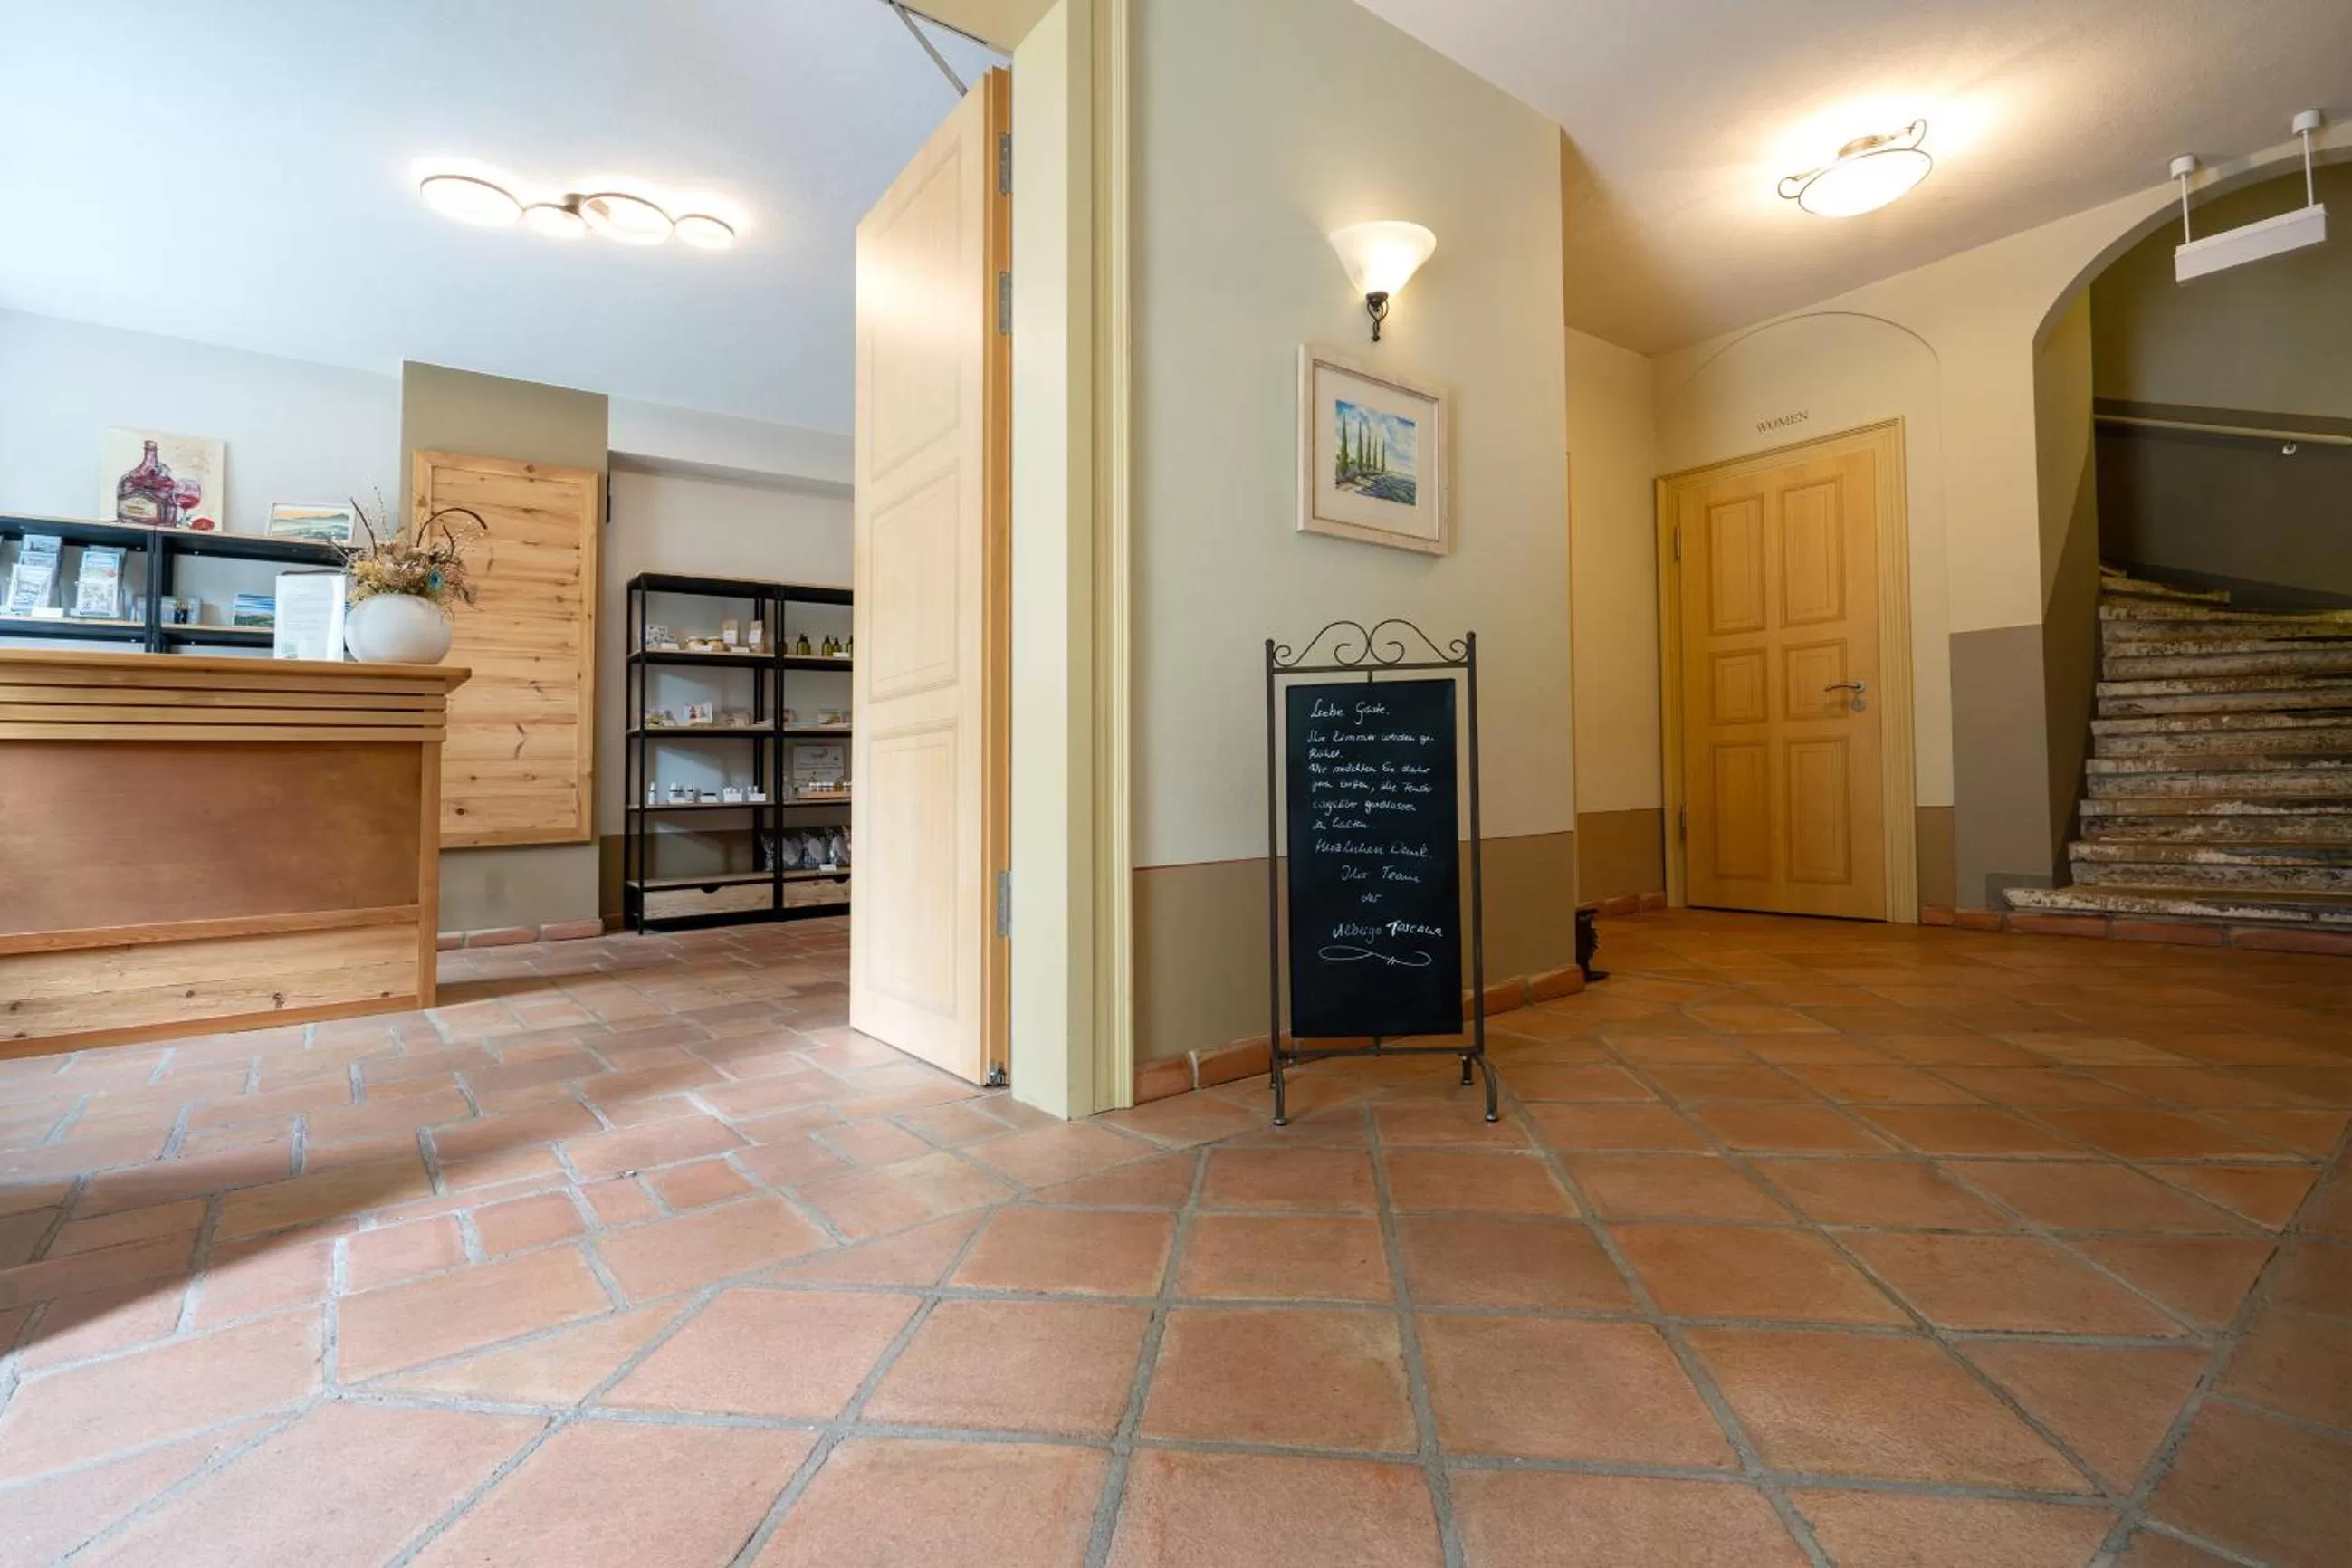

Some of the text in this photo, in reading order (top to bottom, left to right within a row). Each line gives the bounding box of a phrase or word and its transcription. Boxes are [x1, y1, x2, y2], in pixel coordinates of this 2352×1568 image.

[1755, 408, 1809, 433] WOMEN
[1310, 698, 1344, 718] Liebe
[1332, 730, 1376, 743] Zimmer
[1381, 732, 1416, 742] werden
[1308, 762, 1327, 774] Wir
[1332, 762, 1377, 774] möchten
[1380, 780, 1397, 793] die
[1382, 865, 1421, 884] Team
[1360, 892, 1383, 904] der
[1385, 919, 1444, 938] Toscana
